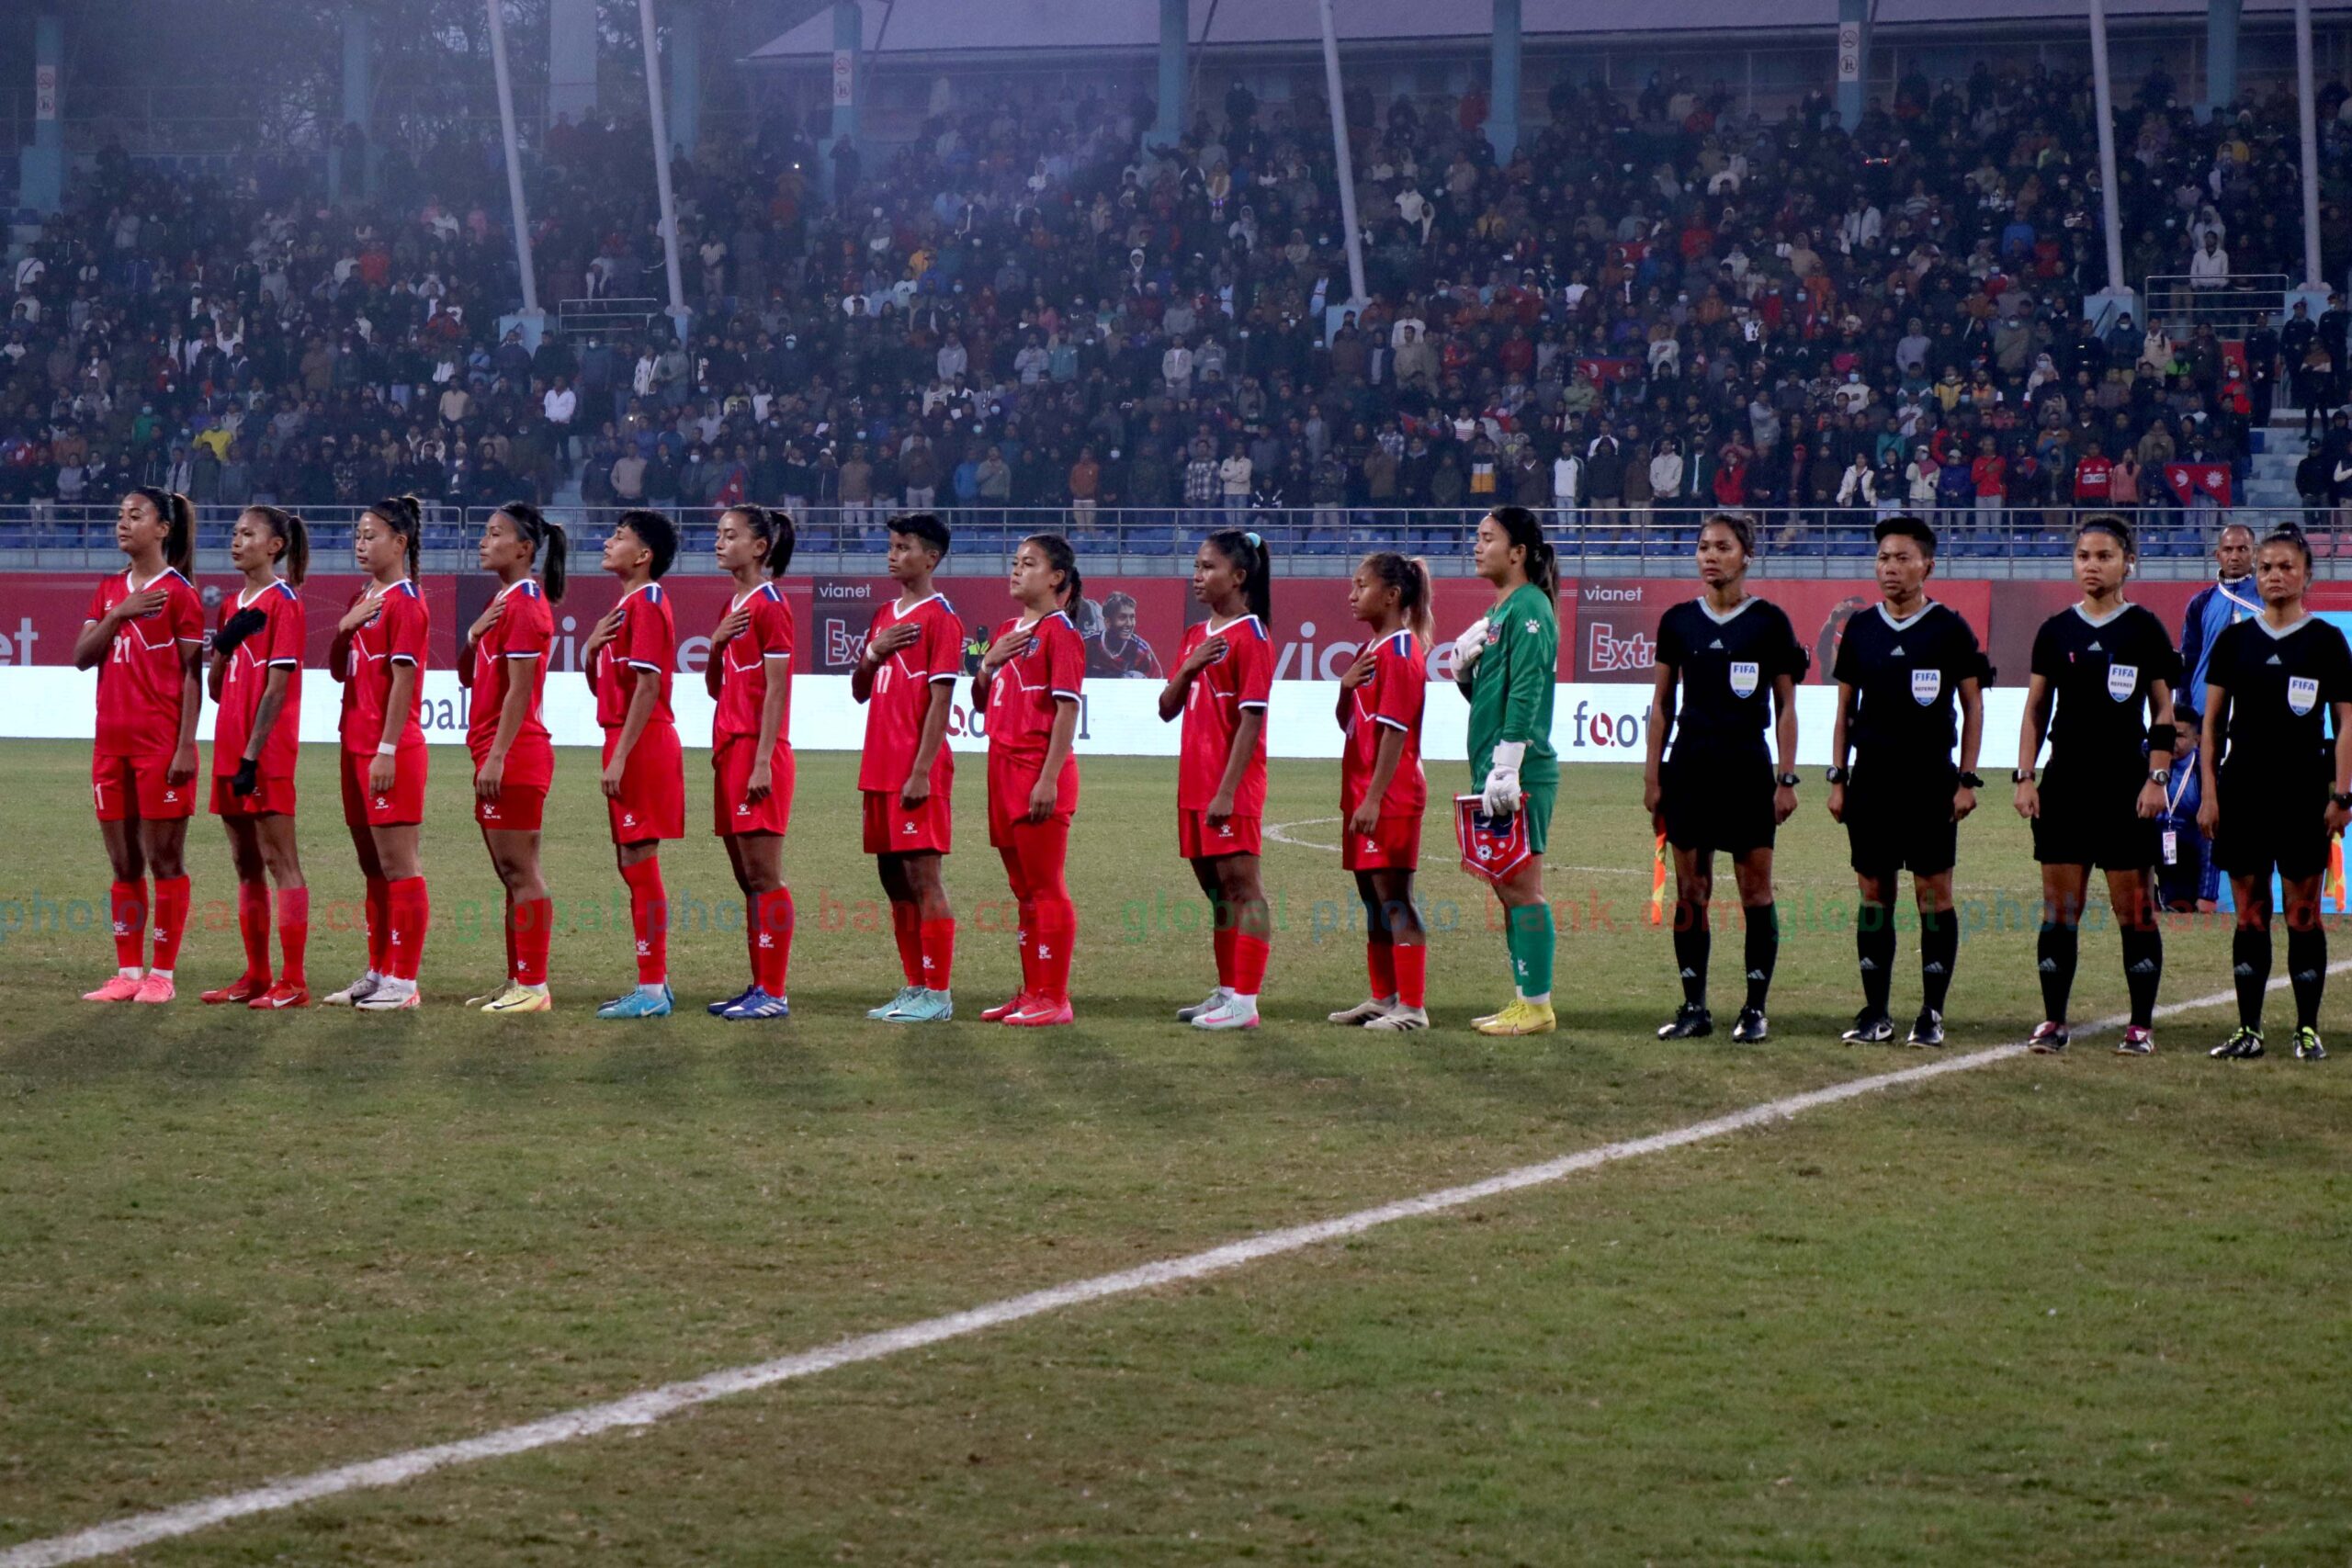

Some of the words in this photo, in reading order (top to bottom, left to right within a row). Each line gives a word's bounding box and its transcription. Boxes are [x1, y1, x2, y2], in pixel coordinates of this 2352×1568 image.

[820, 583, 872, 598] vianet
[1585, 585, 1643, 602] vianet
[113, 635, 130, 663] 21
[1734, 665, 1756, 673] FIFA
[1915, 672, 1938, 681] FIFA
[2112, 667, 2134, 678] FIFA
[874, 664, 892, 694] 17
[2292, 680, 2315, 691] FIFA
[990, 676, 1002, 706] 2
